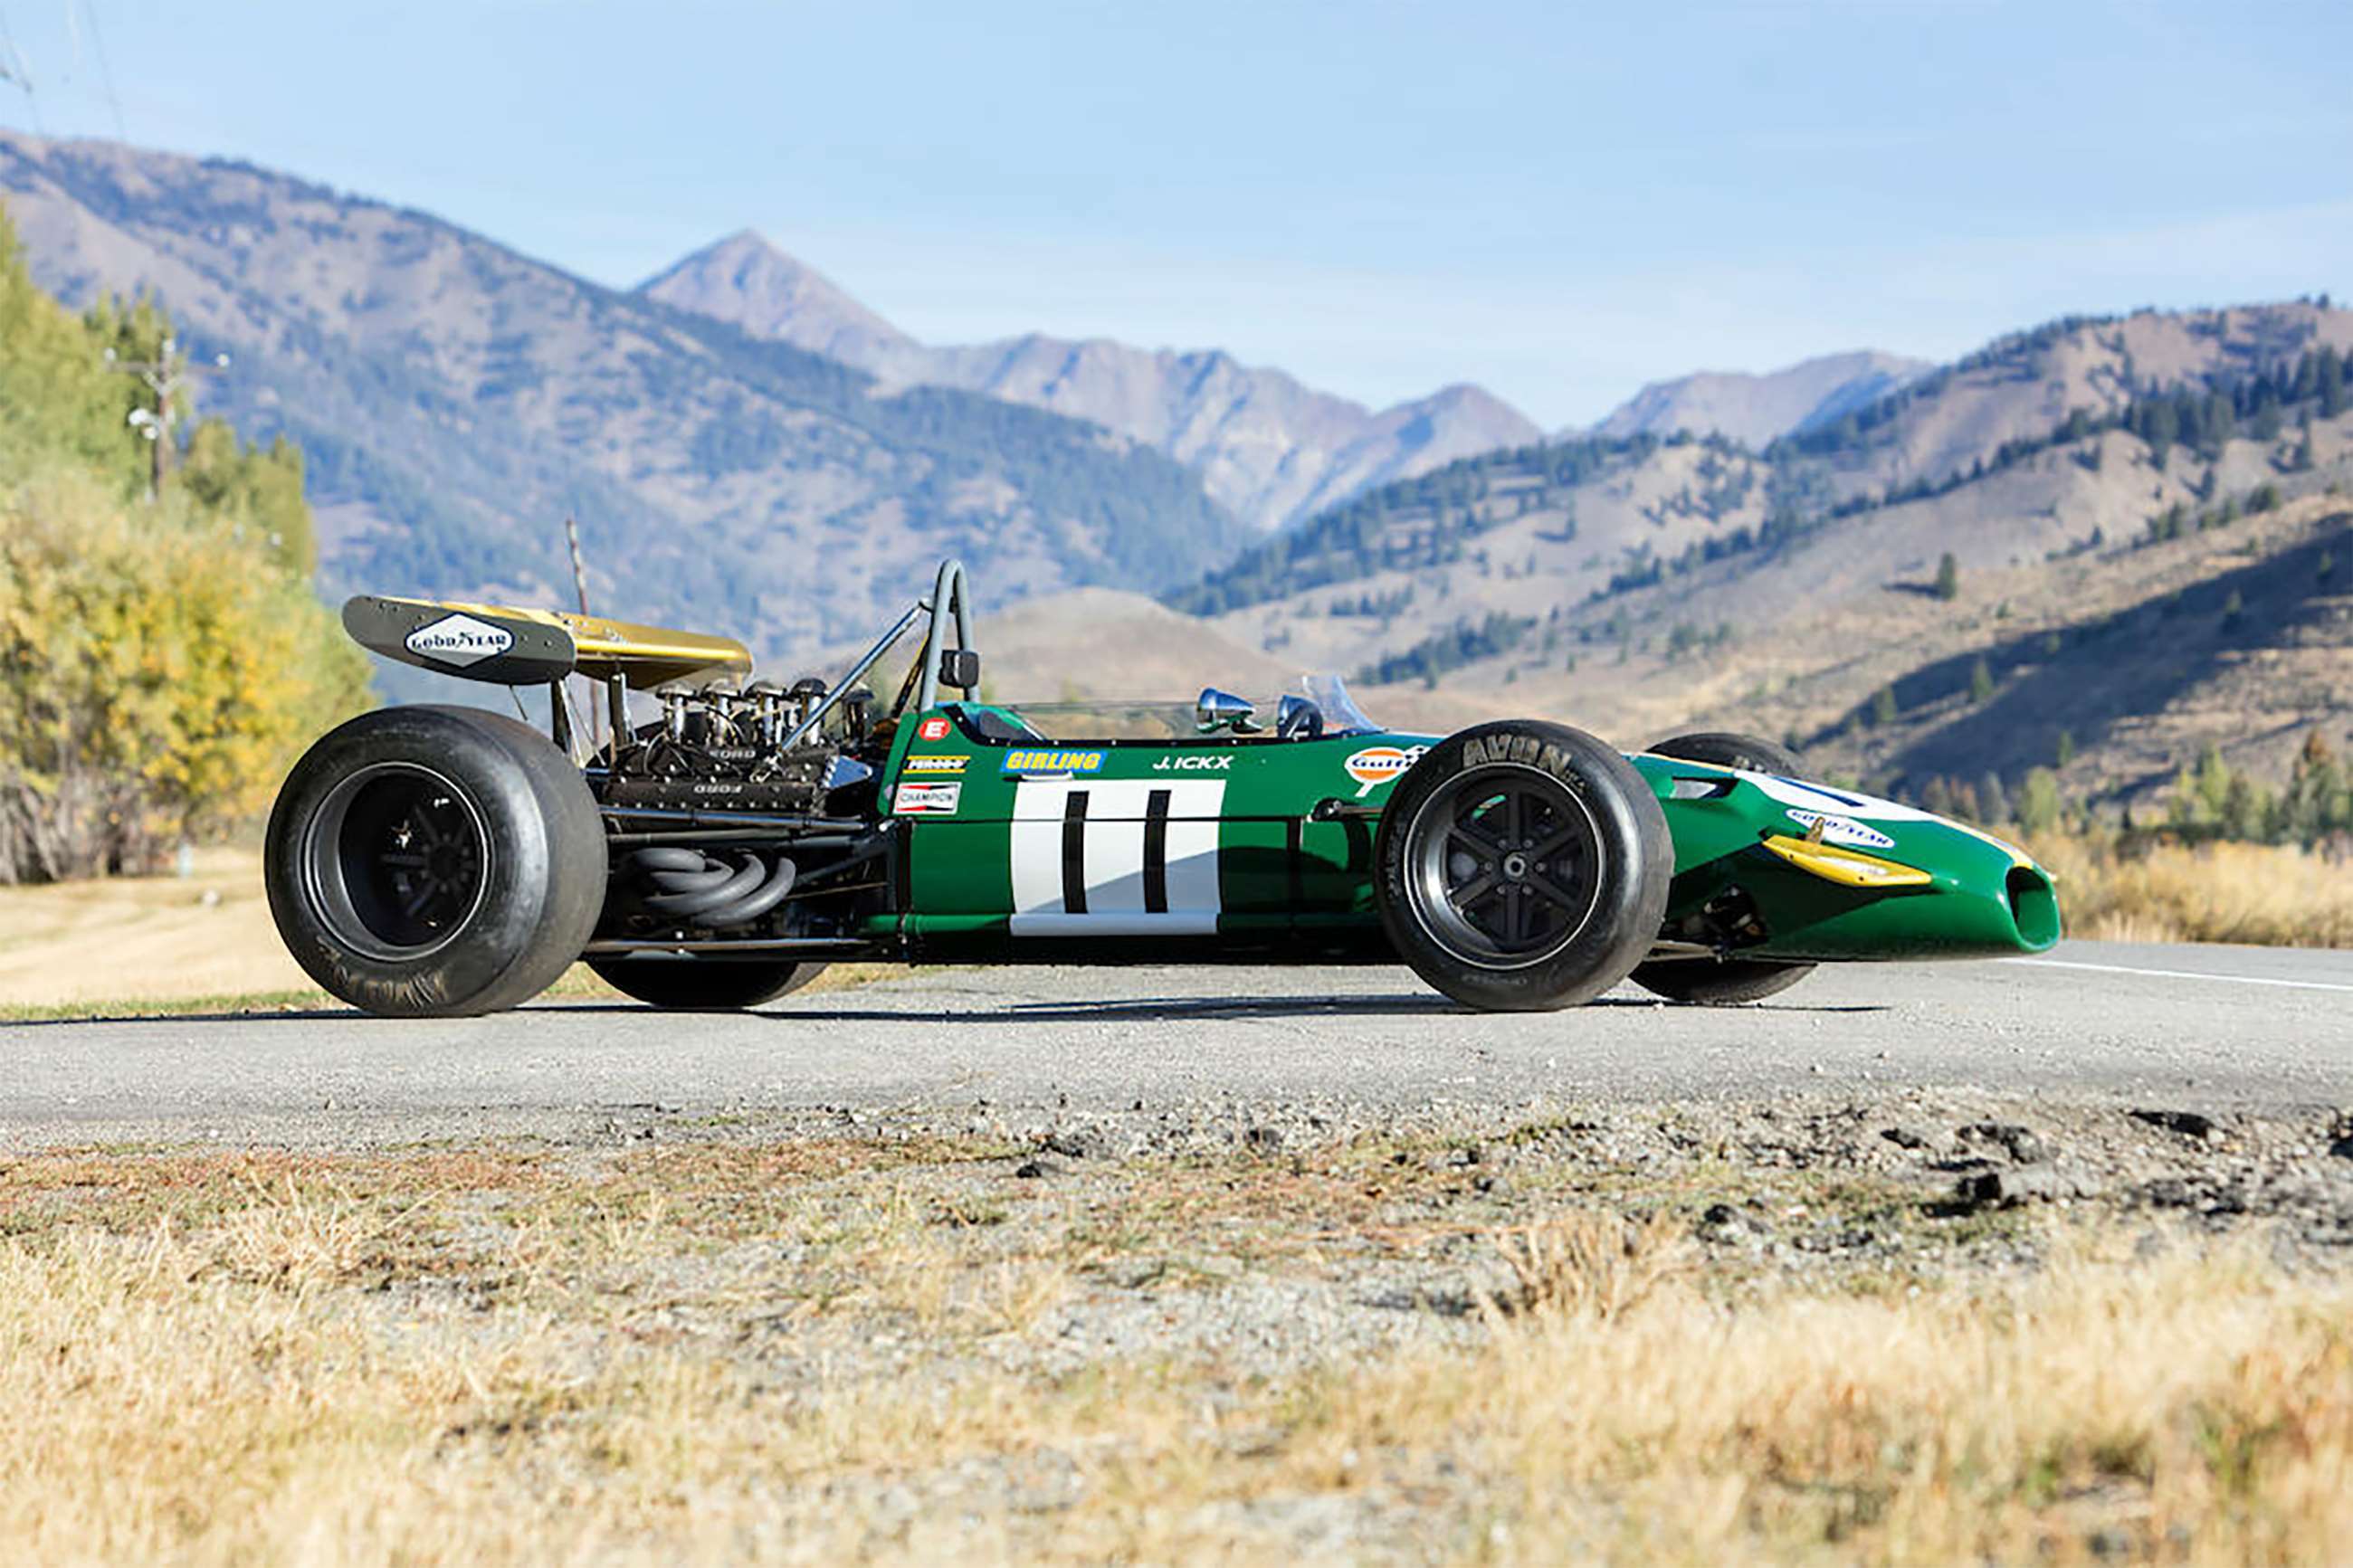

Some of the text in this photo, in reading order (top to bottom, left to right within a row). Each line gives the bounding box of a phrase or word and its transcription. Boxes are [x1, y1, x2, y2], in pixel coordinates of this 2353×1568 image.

[924, 721, 946, 737] E
[1005, 752, 1101, 770] GIRLING
[1351, 756, 1405, 768] Gulf
[1462, 734, 1572, 776] AVON
[1062, 789, 1172, 914] 11
